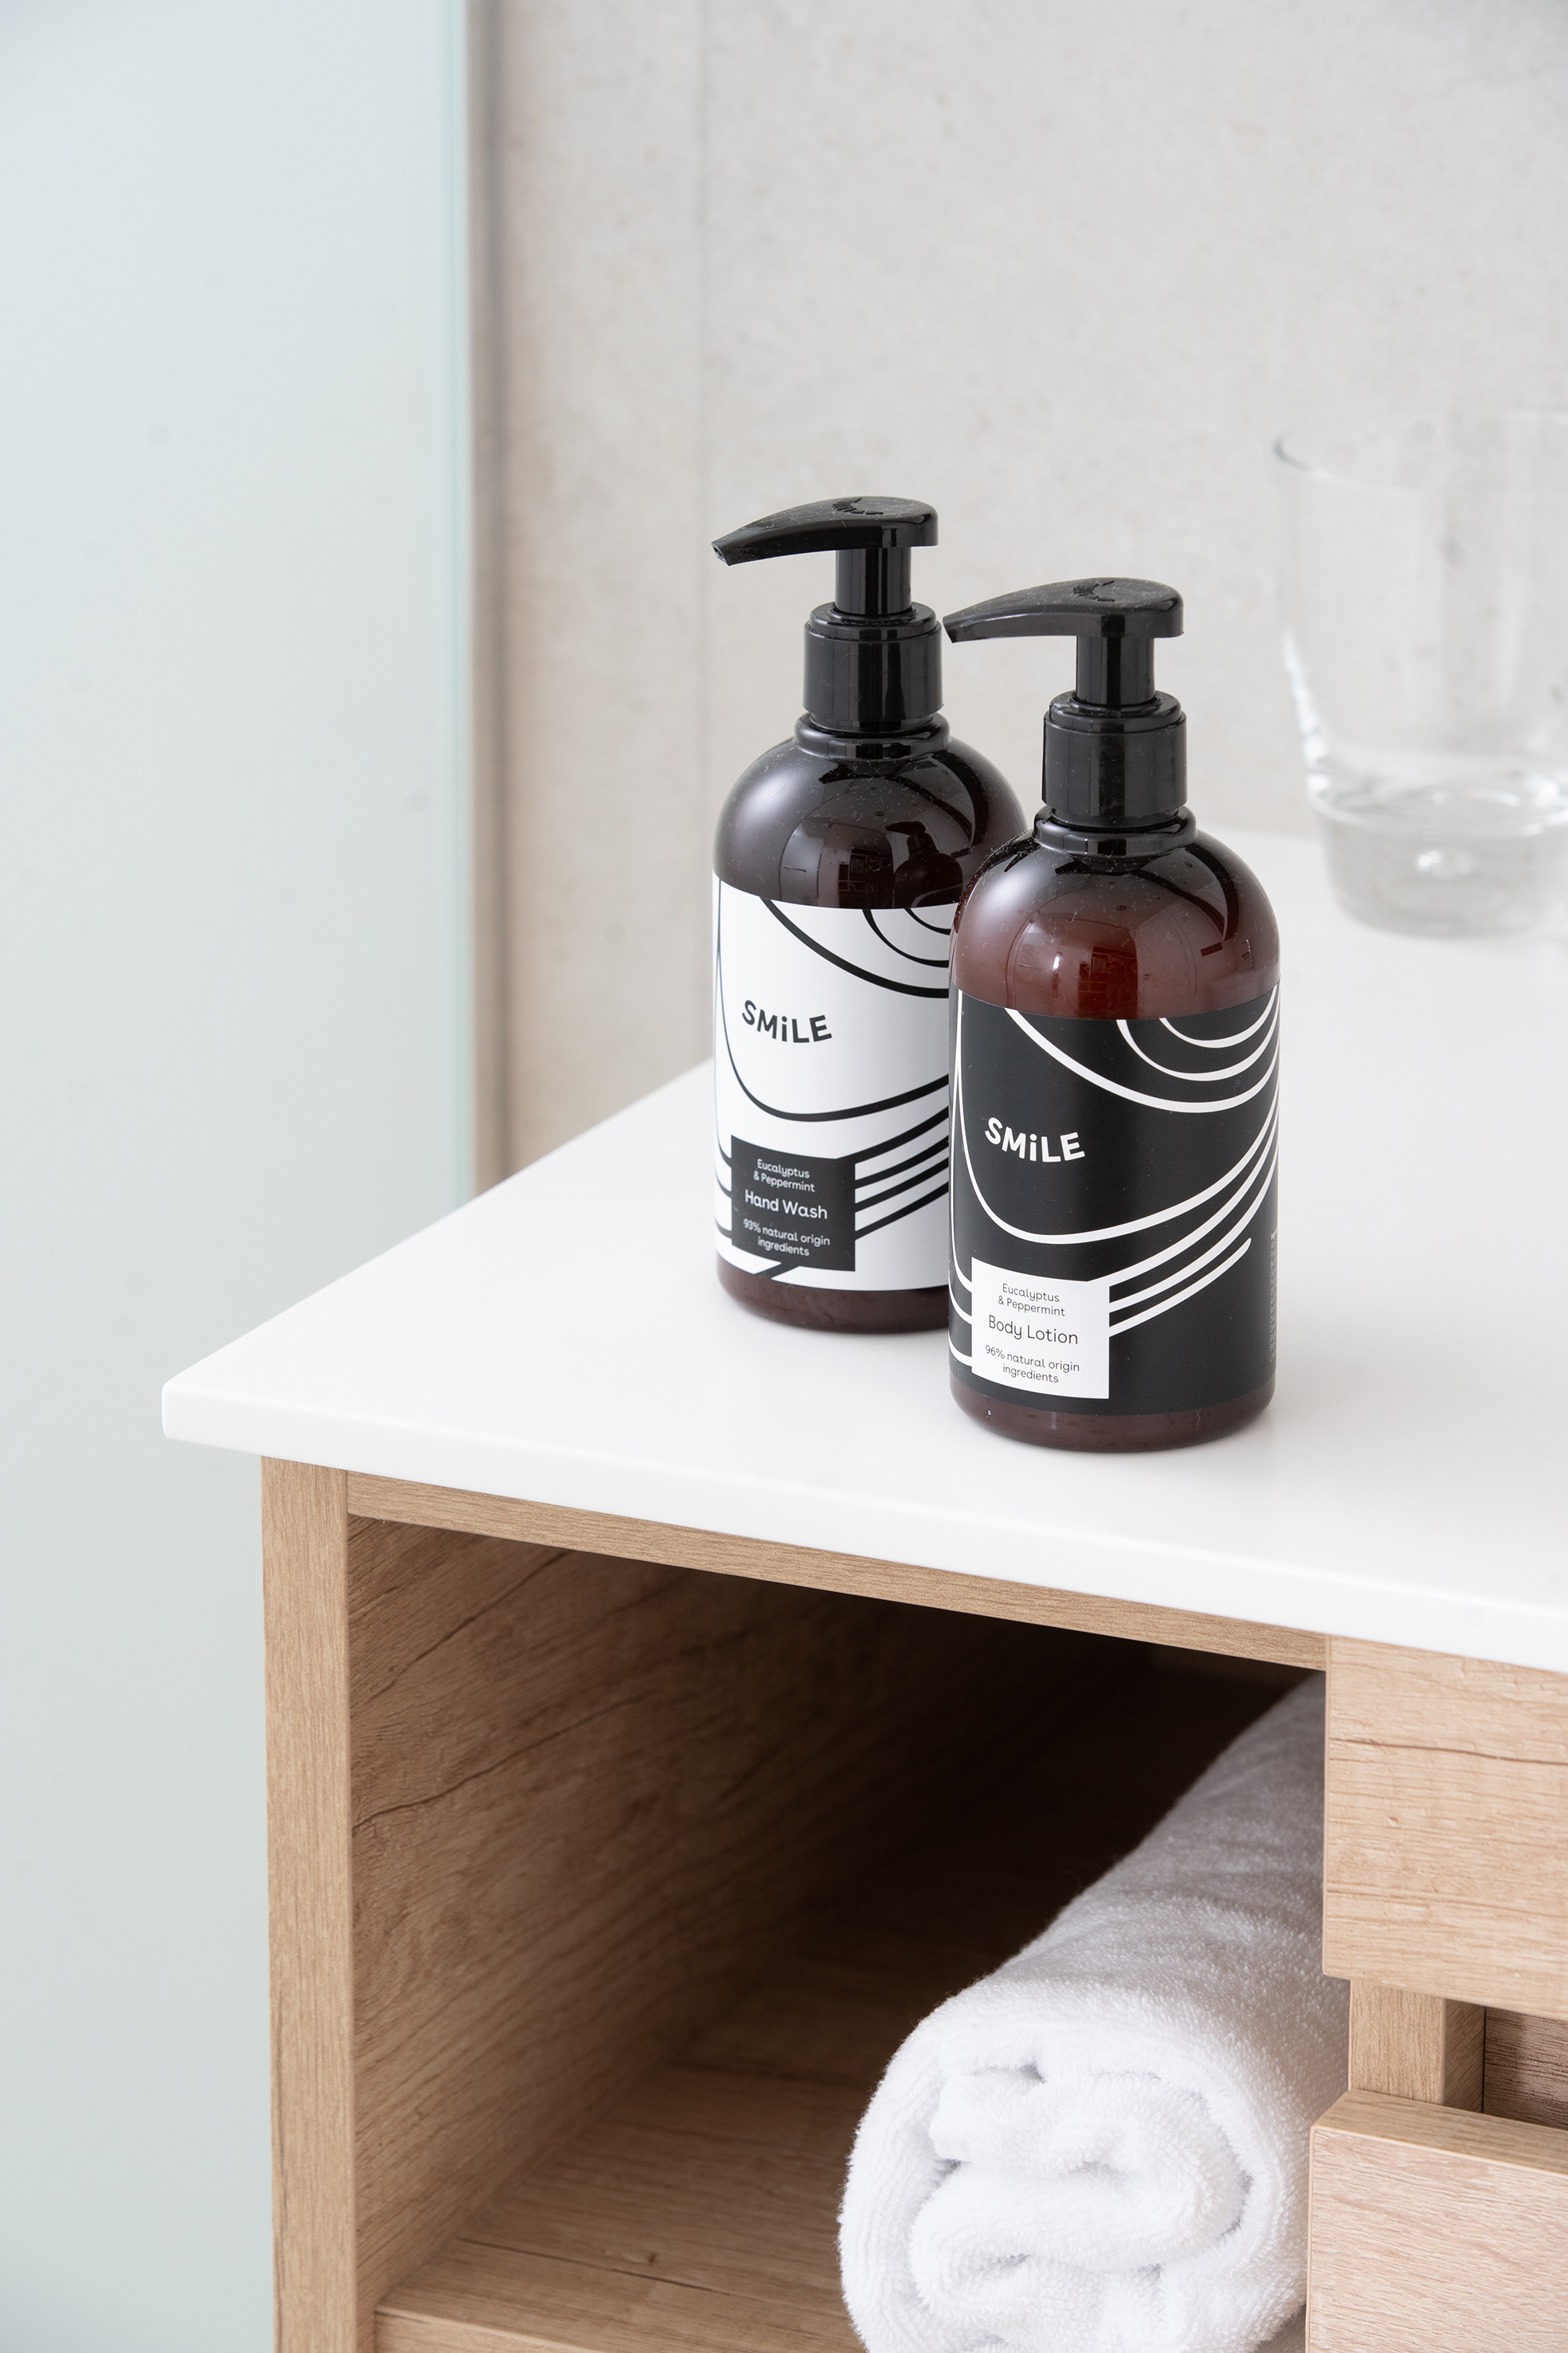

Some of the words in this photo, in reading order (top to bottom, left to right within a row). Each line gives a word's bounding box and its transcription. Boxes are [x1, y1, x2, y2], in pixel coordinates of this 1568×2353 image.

[757, 1158, 810, 1178] Eucalyptus
[753, 1171, 760, 1181] &
[761, 1173, 815, 1192] Peppermint
[745, 1189, 778, 1212] Hand
[782, 1199, 828, 1219] Wash
[743, 1218, 762, 1233] 93%
[762, 1227, 798, 1242] natural
[800, 1234, 830, 1247] origin
[758, 1237, 809, 1257] ingredients
[1002, 1283, 1060, 1302] Eucalyptus
[998, 1295, 1005, 1305] &
[1006, 1297, 1066, 1316] Peppermint
[989, 1315, 1022, 1340] Body
[1027, 1324, 1078, 1345] Lotion
[985, 1344, 1005, 1359] 96%
[1006, 1353, 1045, 1368] natural
[1048, 1360, 1080, 1374] origin
[1002, 1363, 1059, 1383] ingredients
